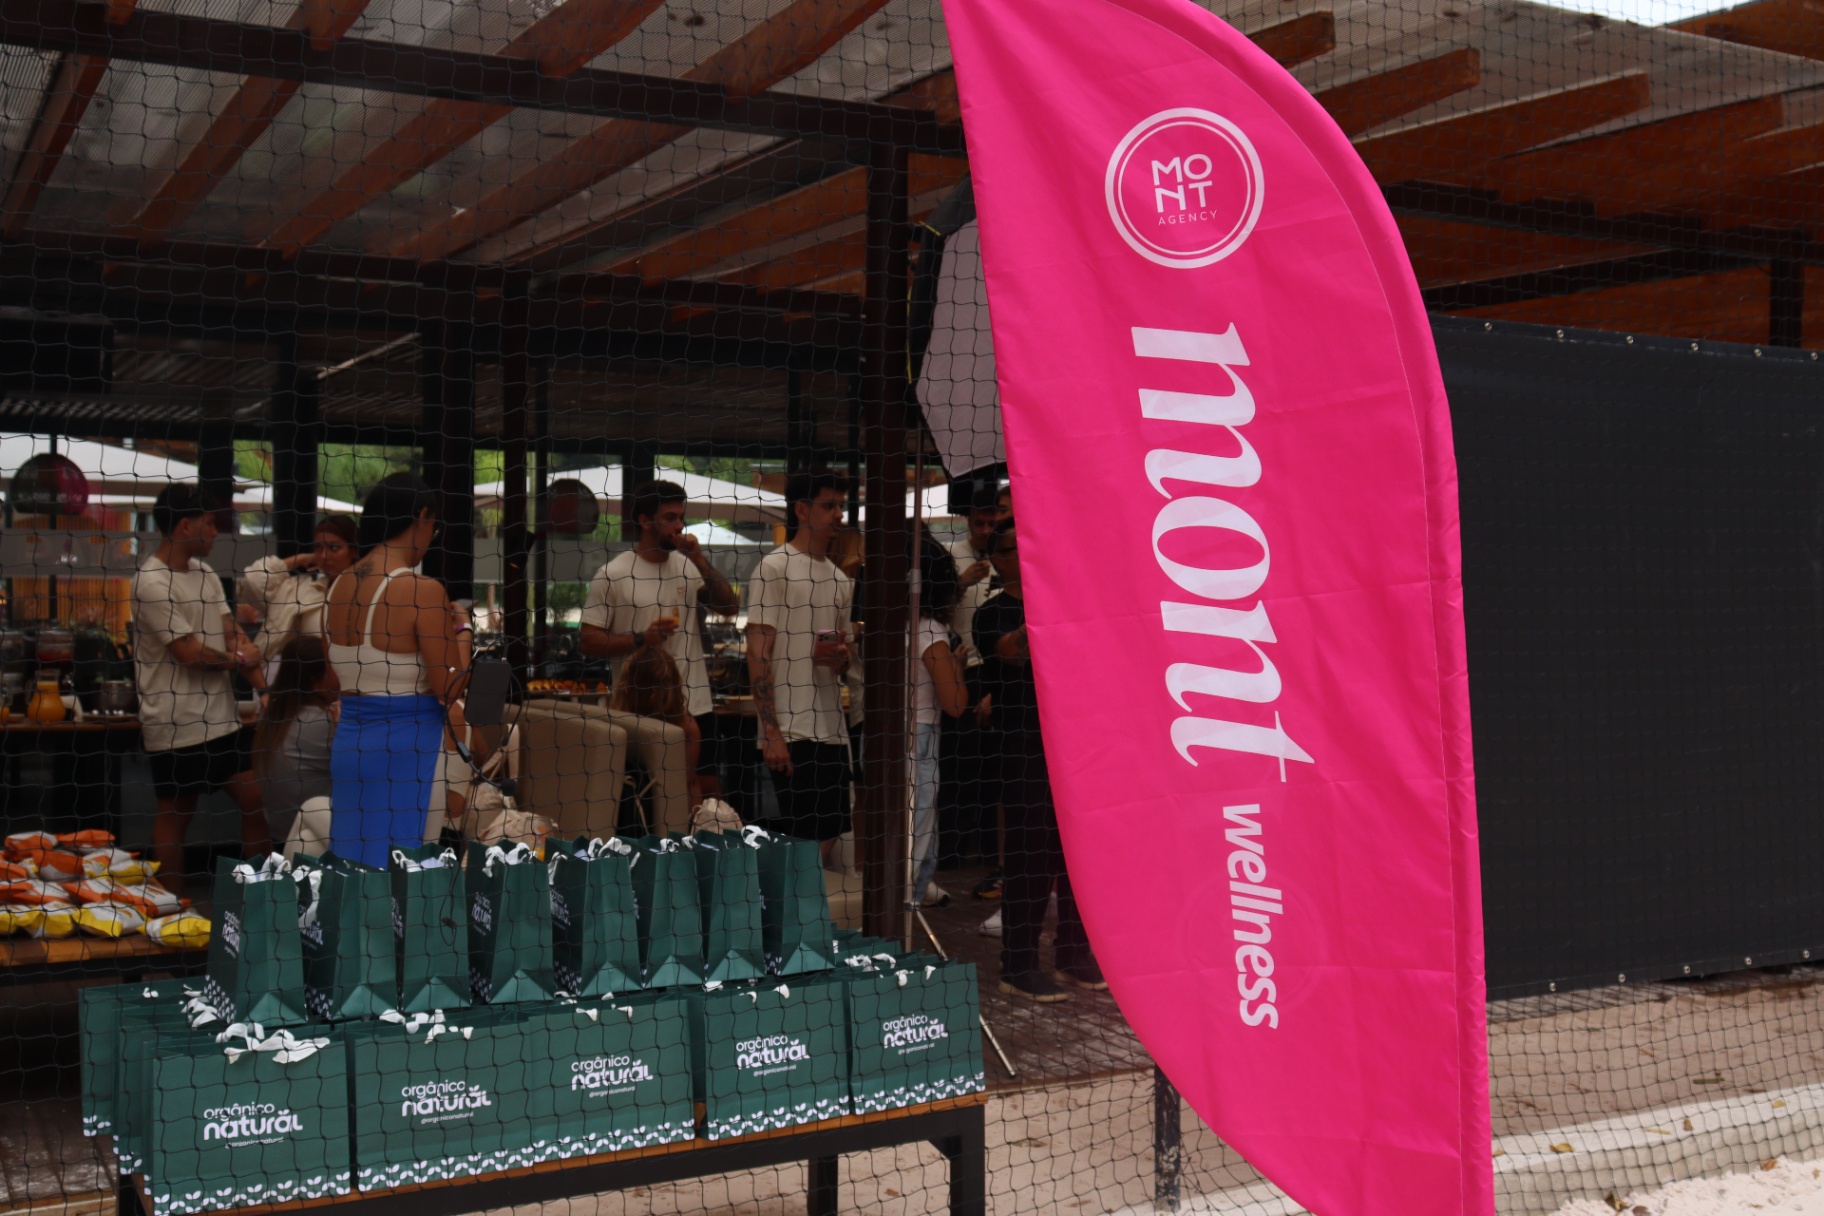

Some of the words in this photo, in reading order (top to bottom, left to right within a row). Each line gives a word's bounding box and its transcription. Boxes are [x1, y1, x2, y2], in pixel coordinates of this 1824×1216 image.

[1157, 209, 1218, 226] AGENCY
[1130, 321, 1316, 783] mont
[1222, 803, 1284, 1030] wellness
[883, 1013, 929, 1033] orgânico
[883, 1020, 949, 1049] natural
[735, 1035, 788, 1053] orgânico
[737, 1042, 811, 1070] natural
[571, 1054, 630, 1074] orgânico
[571, 1062, 654, 1091] natural
[401, 1079, 466, 1099] orgânico
[401, 1088, 492, 1117] natural
[203, 1101, 275, 1121] orgânico
[203, 1112, 303, 1141] natural
